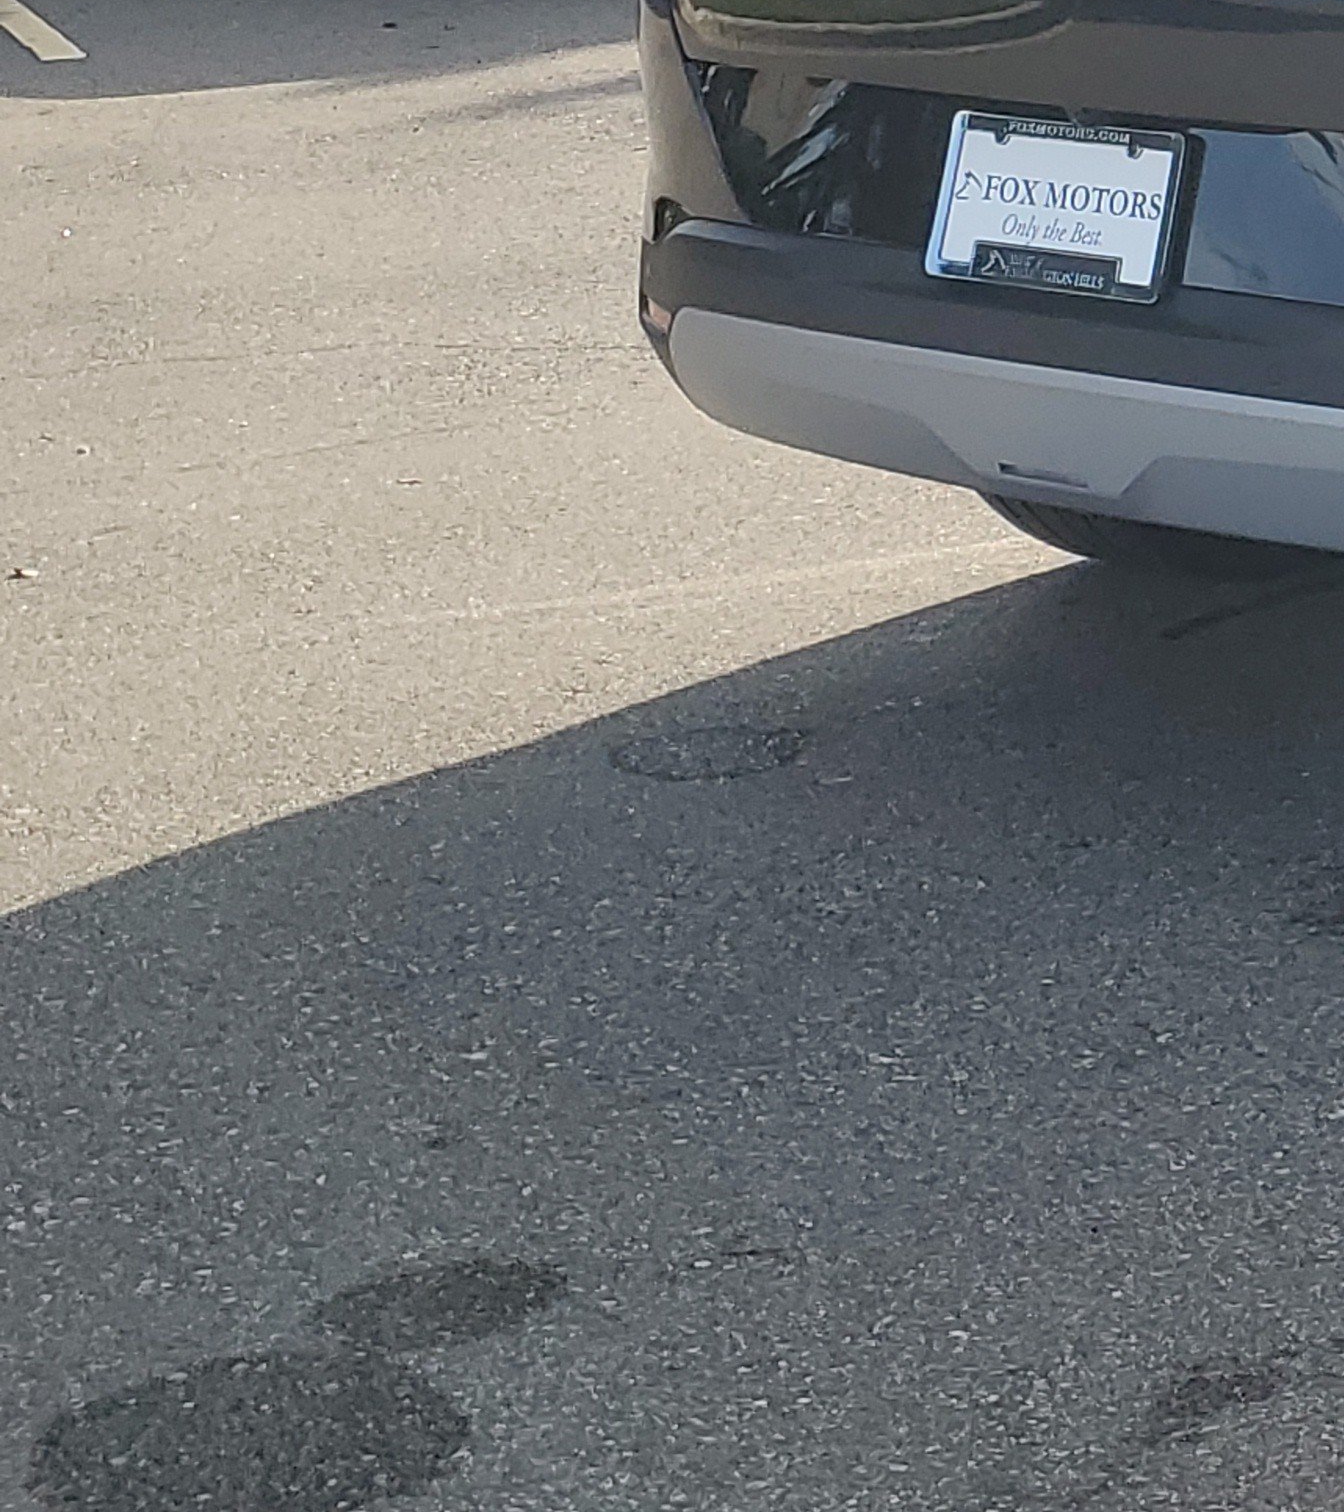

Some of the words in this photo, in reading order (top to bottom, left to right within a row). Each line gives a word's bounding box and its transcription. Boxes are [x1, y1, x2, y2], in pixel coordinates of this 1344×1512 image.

[982, 174, 1041, 206] FOX
[1044, 182, 1162, 221] MOTORS
[1002, 213, 1038, 244] Only
[1042, 218, 1067, 243] the
